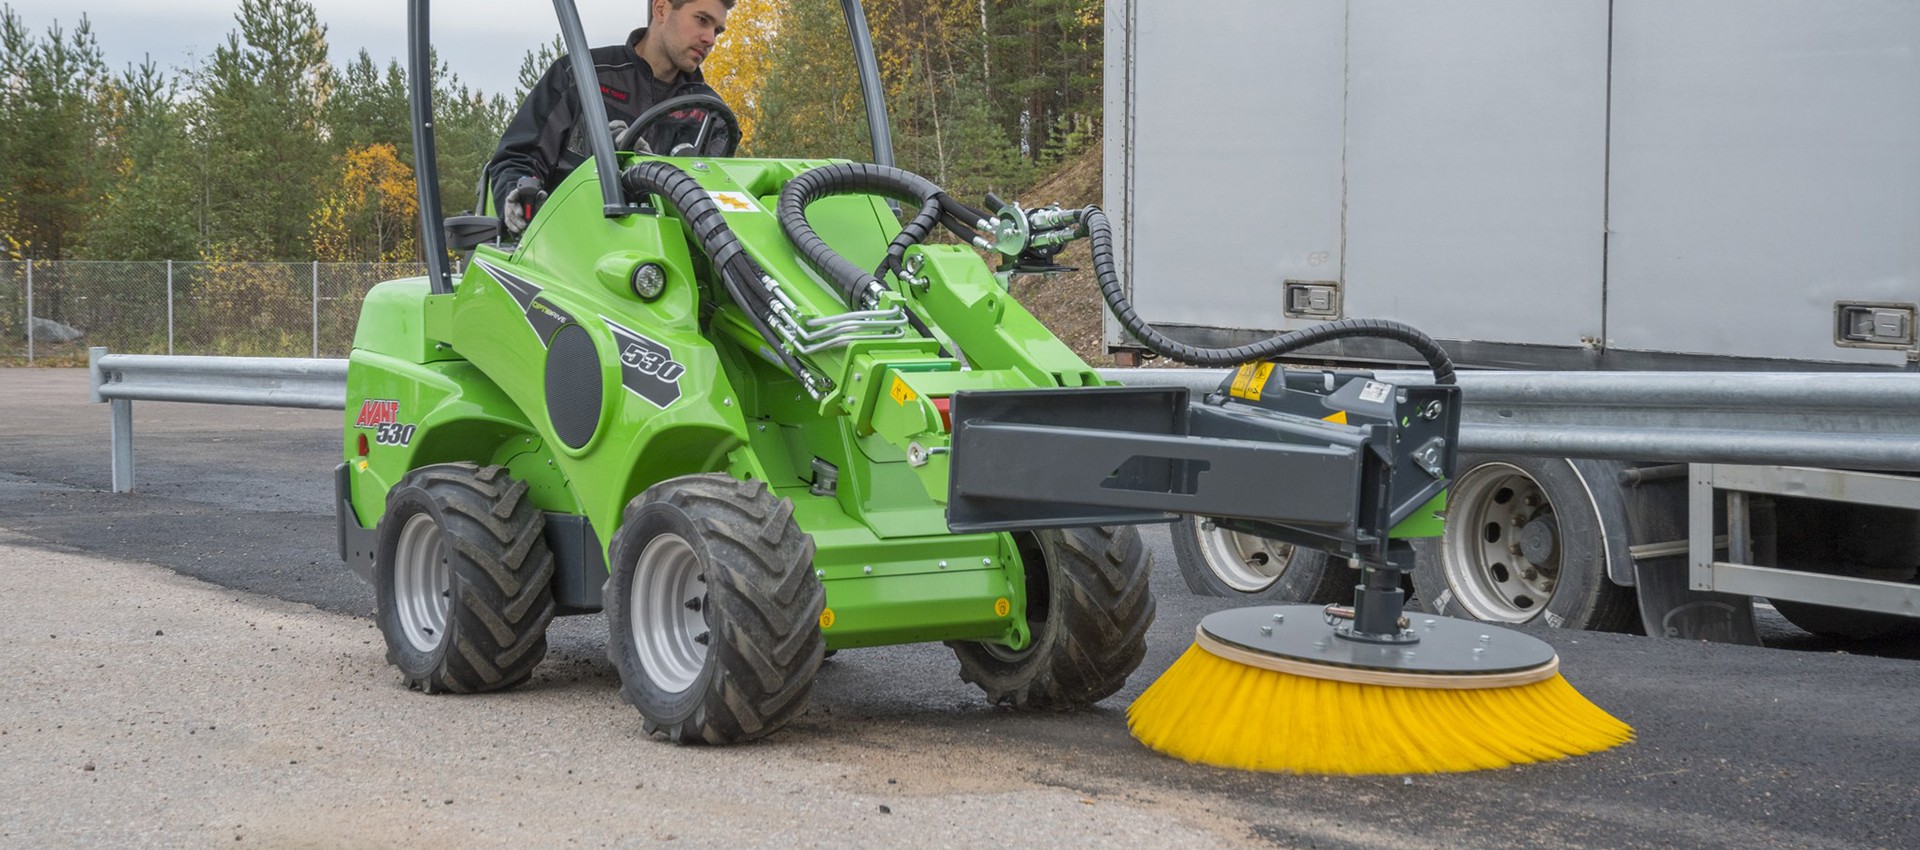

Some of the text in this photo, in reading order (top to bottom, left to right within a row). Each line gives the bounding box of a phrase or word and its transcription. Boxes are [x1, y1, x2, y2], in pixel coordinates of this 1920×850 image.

[621, 343, 686, 383] 530
[354, 398, 400, 429] AVANT
[376, 422, 417, 448] 530
